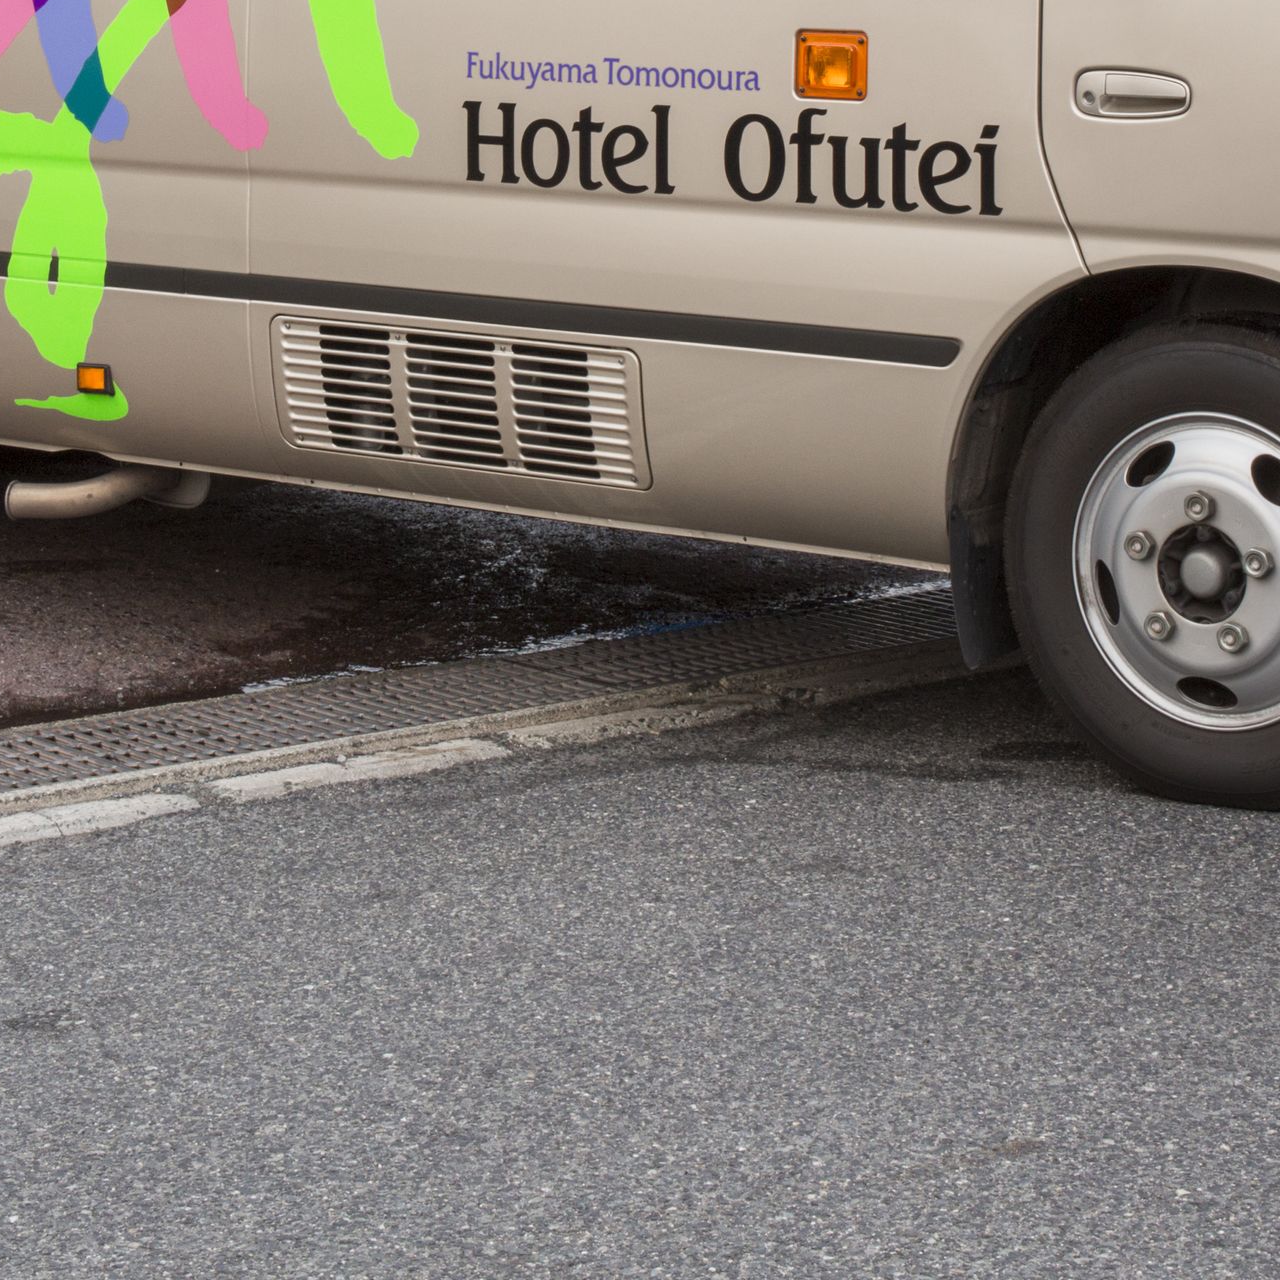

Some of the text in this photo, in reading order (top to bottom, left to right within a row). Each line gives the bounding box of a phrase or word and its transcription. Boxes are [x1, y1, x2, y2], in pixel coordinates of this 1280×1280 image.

[466, 51, 761, 92] Fukuyama Tomonoura
[462, 100, 1004, 217] Hotel Ofutei
